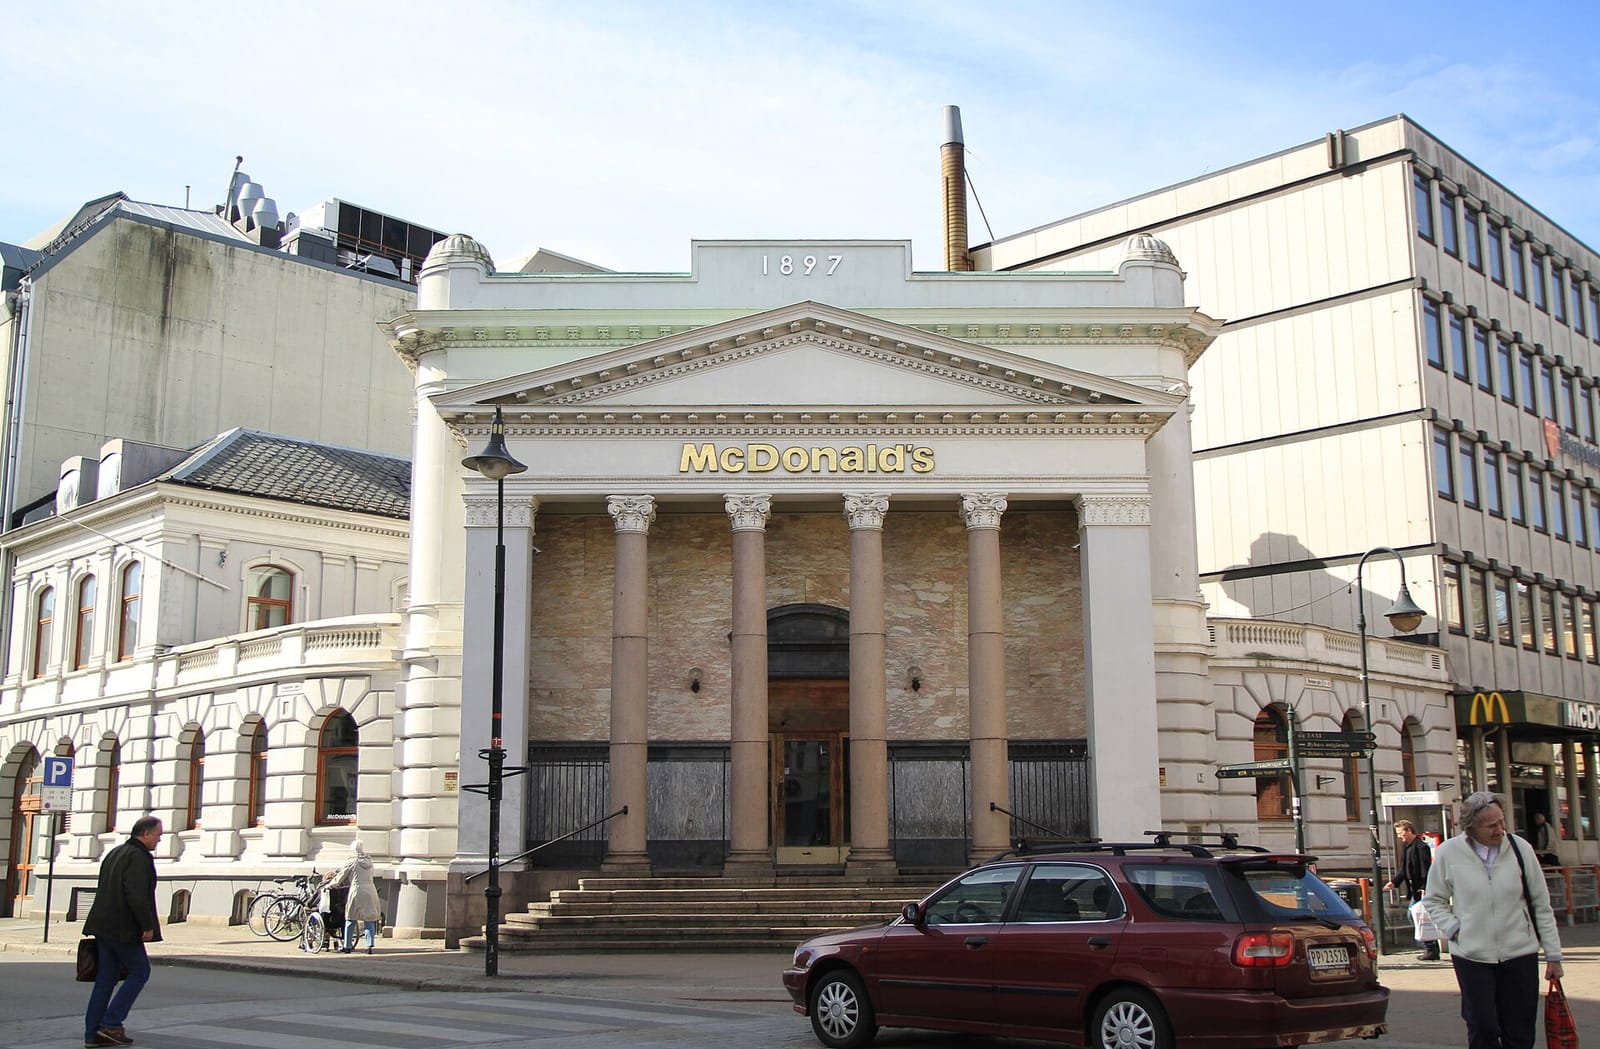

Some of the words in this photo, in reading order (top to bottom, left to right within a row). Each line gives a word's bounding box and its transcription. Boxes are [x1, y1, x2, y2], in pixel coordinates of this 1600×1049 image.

[762, 255, 843, 275] 1897
[679, 443, 936, 473] McDonald's
[51, 761, 67, 784] P
[1310, 951, 1321, 964] PP
[1323, 949, 1348, 963] 23528
